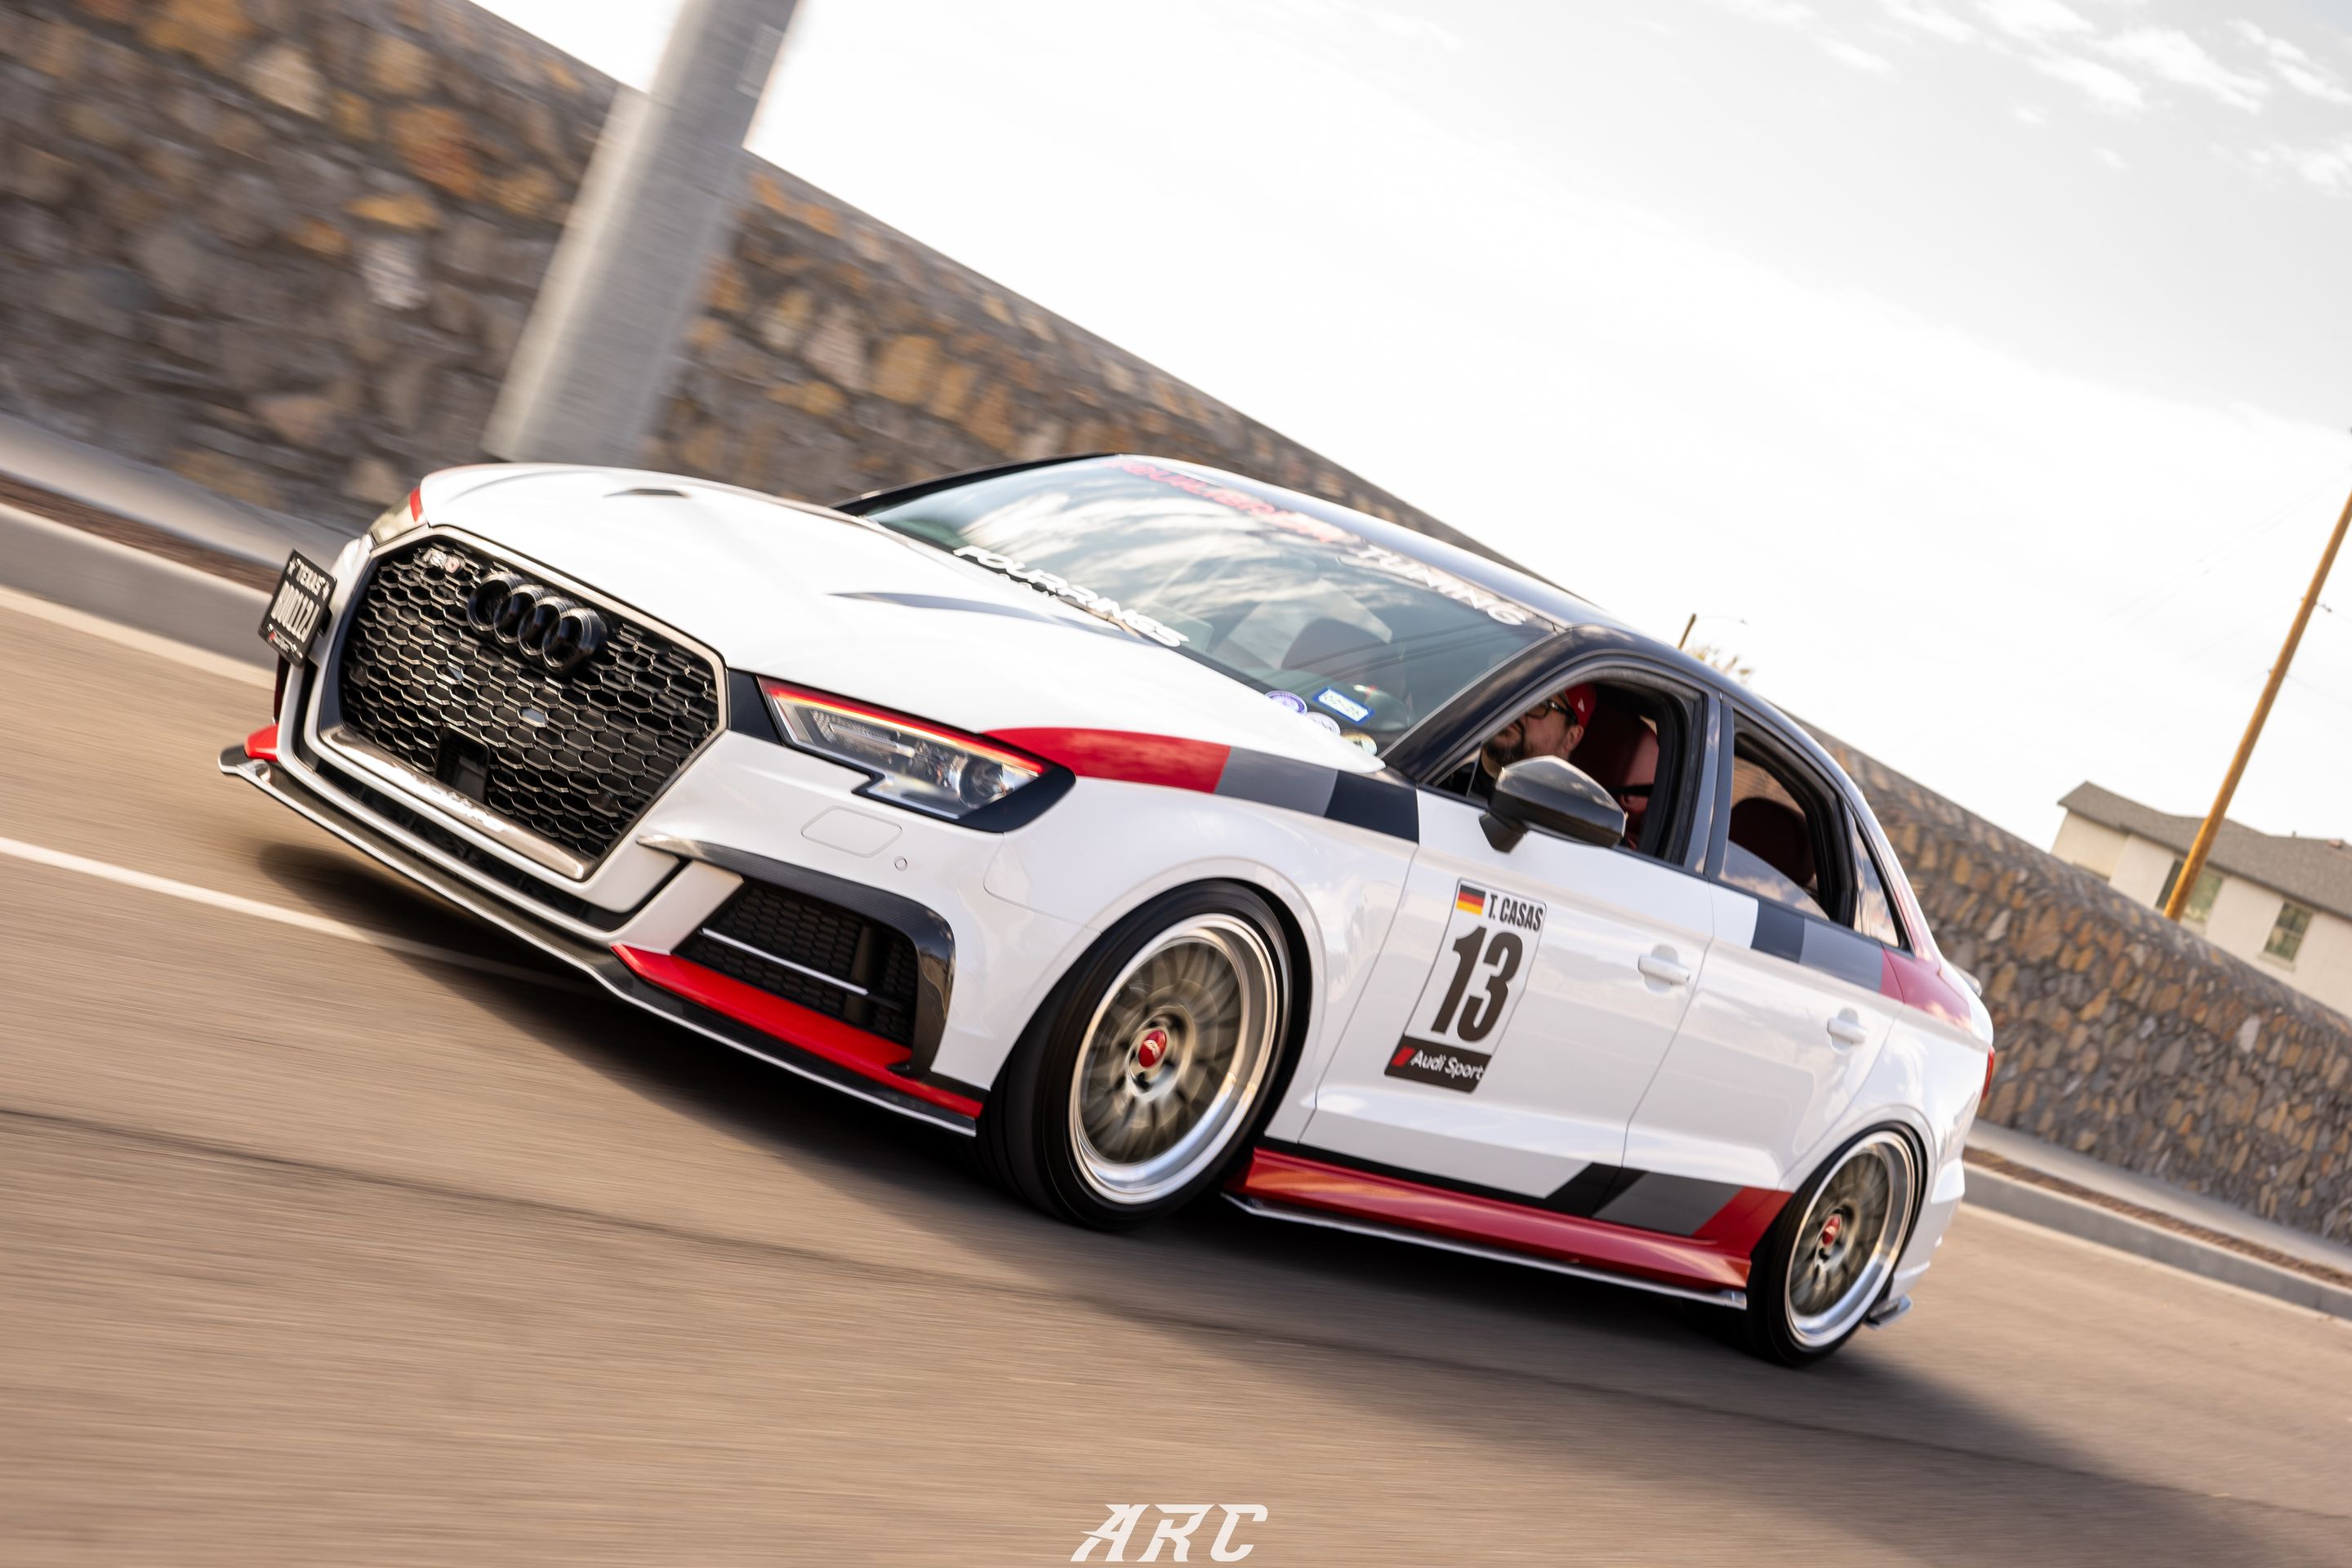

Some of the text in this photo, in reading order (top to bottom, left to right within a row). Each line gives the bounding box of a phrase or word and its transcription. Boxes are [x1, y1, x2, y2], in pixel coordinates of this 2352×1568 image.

[295, 561, 326, 597] TEXAS
[1487, 893, 1544, 933] T. CASAS
[1430, 925, 1524, 1044] 13
[1410, 1049, 1485, 1082] Audi Sport
